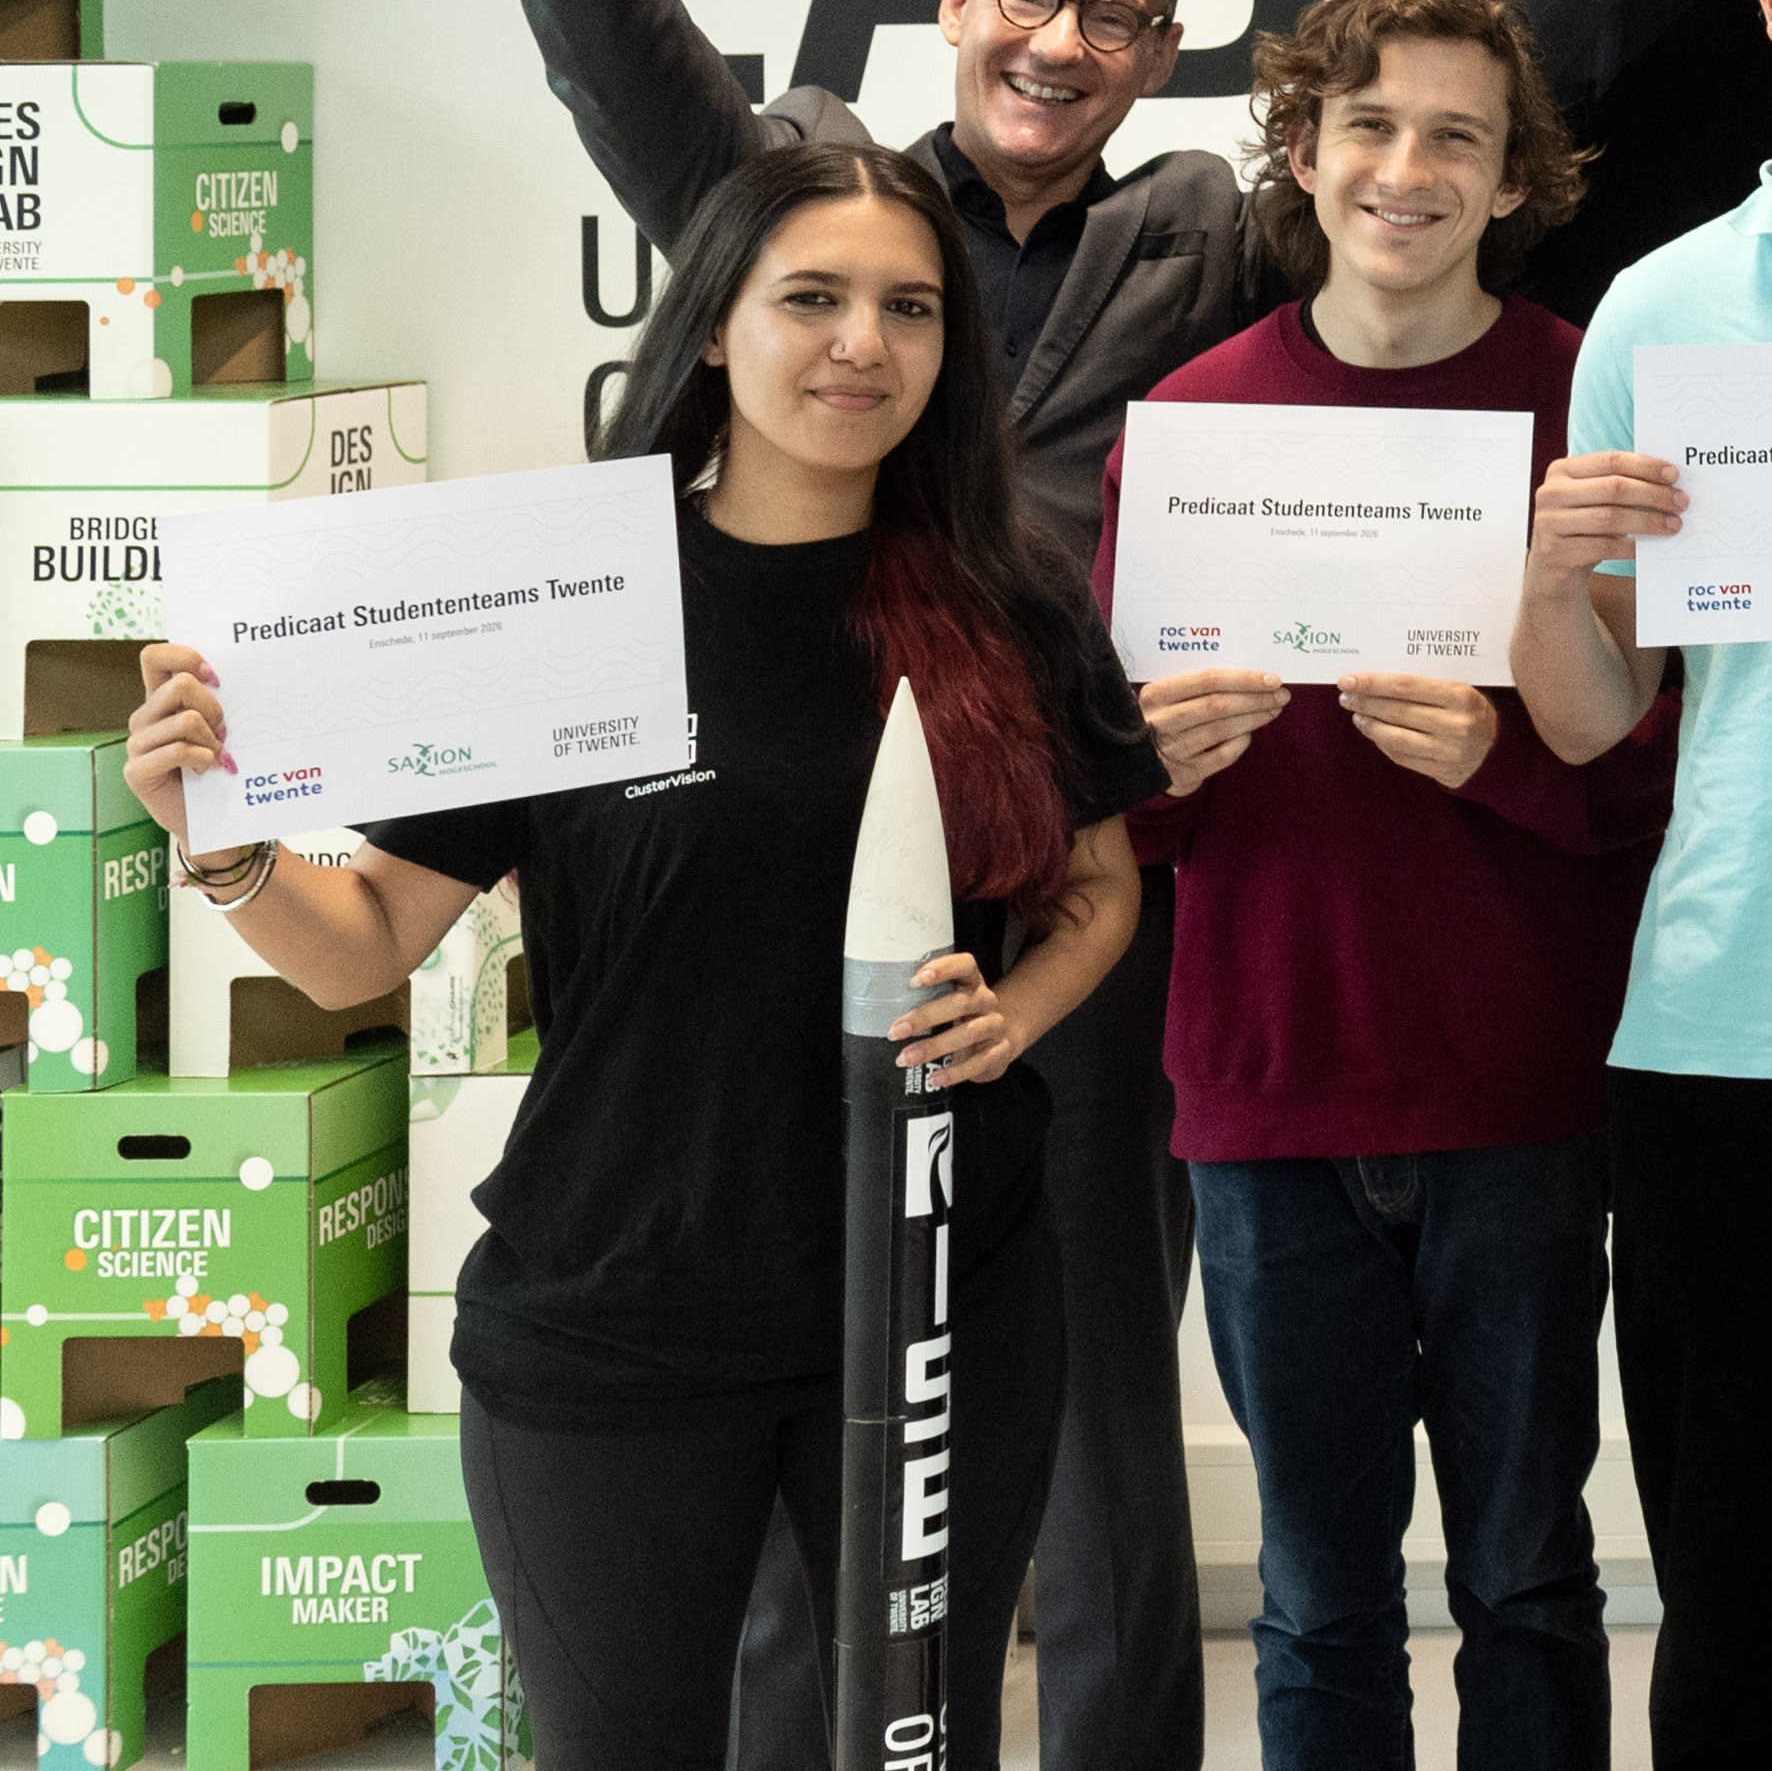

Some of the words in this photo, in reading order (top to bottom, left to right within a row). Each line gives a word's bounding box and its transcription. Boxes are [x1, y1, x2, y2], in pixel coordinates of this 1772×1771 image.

[0, 101, 41, 141] ES
[195, 171, 277, 211] CITIZEN
[0, 192, 41, 231] AB
[208, 210, 267, 238] SCIENCE
[0, 257, 43, 271] ENTE.
[330, 425, 373, 468] DES
[1167, 496, 1256, 517] Predicaat
[1260, 497, 1412, 520] Studententeams
[1417, 502, 1483, 522] Twente
[1309, 528, 1318, 537] 11
[33, 545, 163, 582] BUILD
[1686, 596, 1752, 612] twente
[1687, 585, 1716, 597] roc
[1719, 584, 1752, 595] van
[232, 609, 347, 645] Predicaat
[353, 584, 540, 629] Studententeams
[546, 569, 626, 600] Twente
[369, 634, 416, 649] Enschede,
[418, 632, 429, 643] 11
[431, 627, 478, 642] september
[480, 621, 503, 635] 2026
[1158, 638, 1220, 652] twente
[1160, 626, 1187, 637] roc
[1189, 626, 1221, 637] van
[1272, 621, 1341, 654] SAXION
[1407, 629, 1480, 644] UNIVERSITY
[1406, 642, 1422, 656] OF
[1425, 643, 1480, 657] TWENTE.
[552, 715, 640, 743] UNIVERSITY
[553, 740, 573, 759] OF
[575, 731, 642, 755] TWENTE.
[387, 742, 473, 778] SAXION
[244, 772, 278, 790] roc
[282, 765, 322, 784] van
[625, 769, 716, 799] ClusterVision
[244, 780, 323, 807] twente
[74, 1209, 231, 1250] CITIZEN
[366, 1205, 407, 1250] DESIG
[98, 1252, 208, 1279] SCIENCE
[119, 1510, 188, 1590] RESPO
[260, 1554, 422, 1596] IMPACT
[292, 1597, 389, 1624] MAKER
[910, 1583, 930, 1631] LAB
